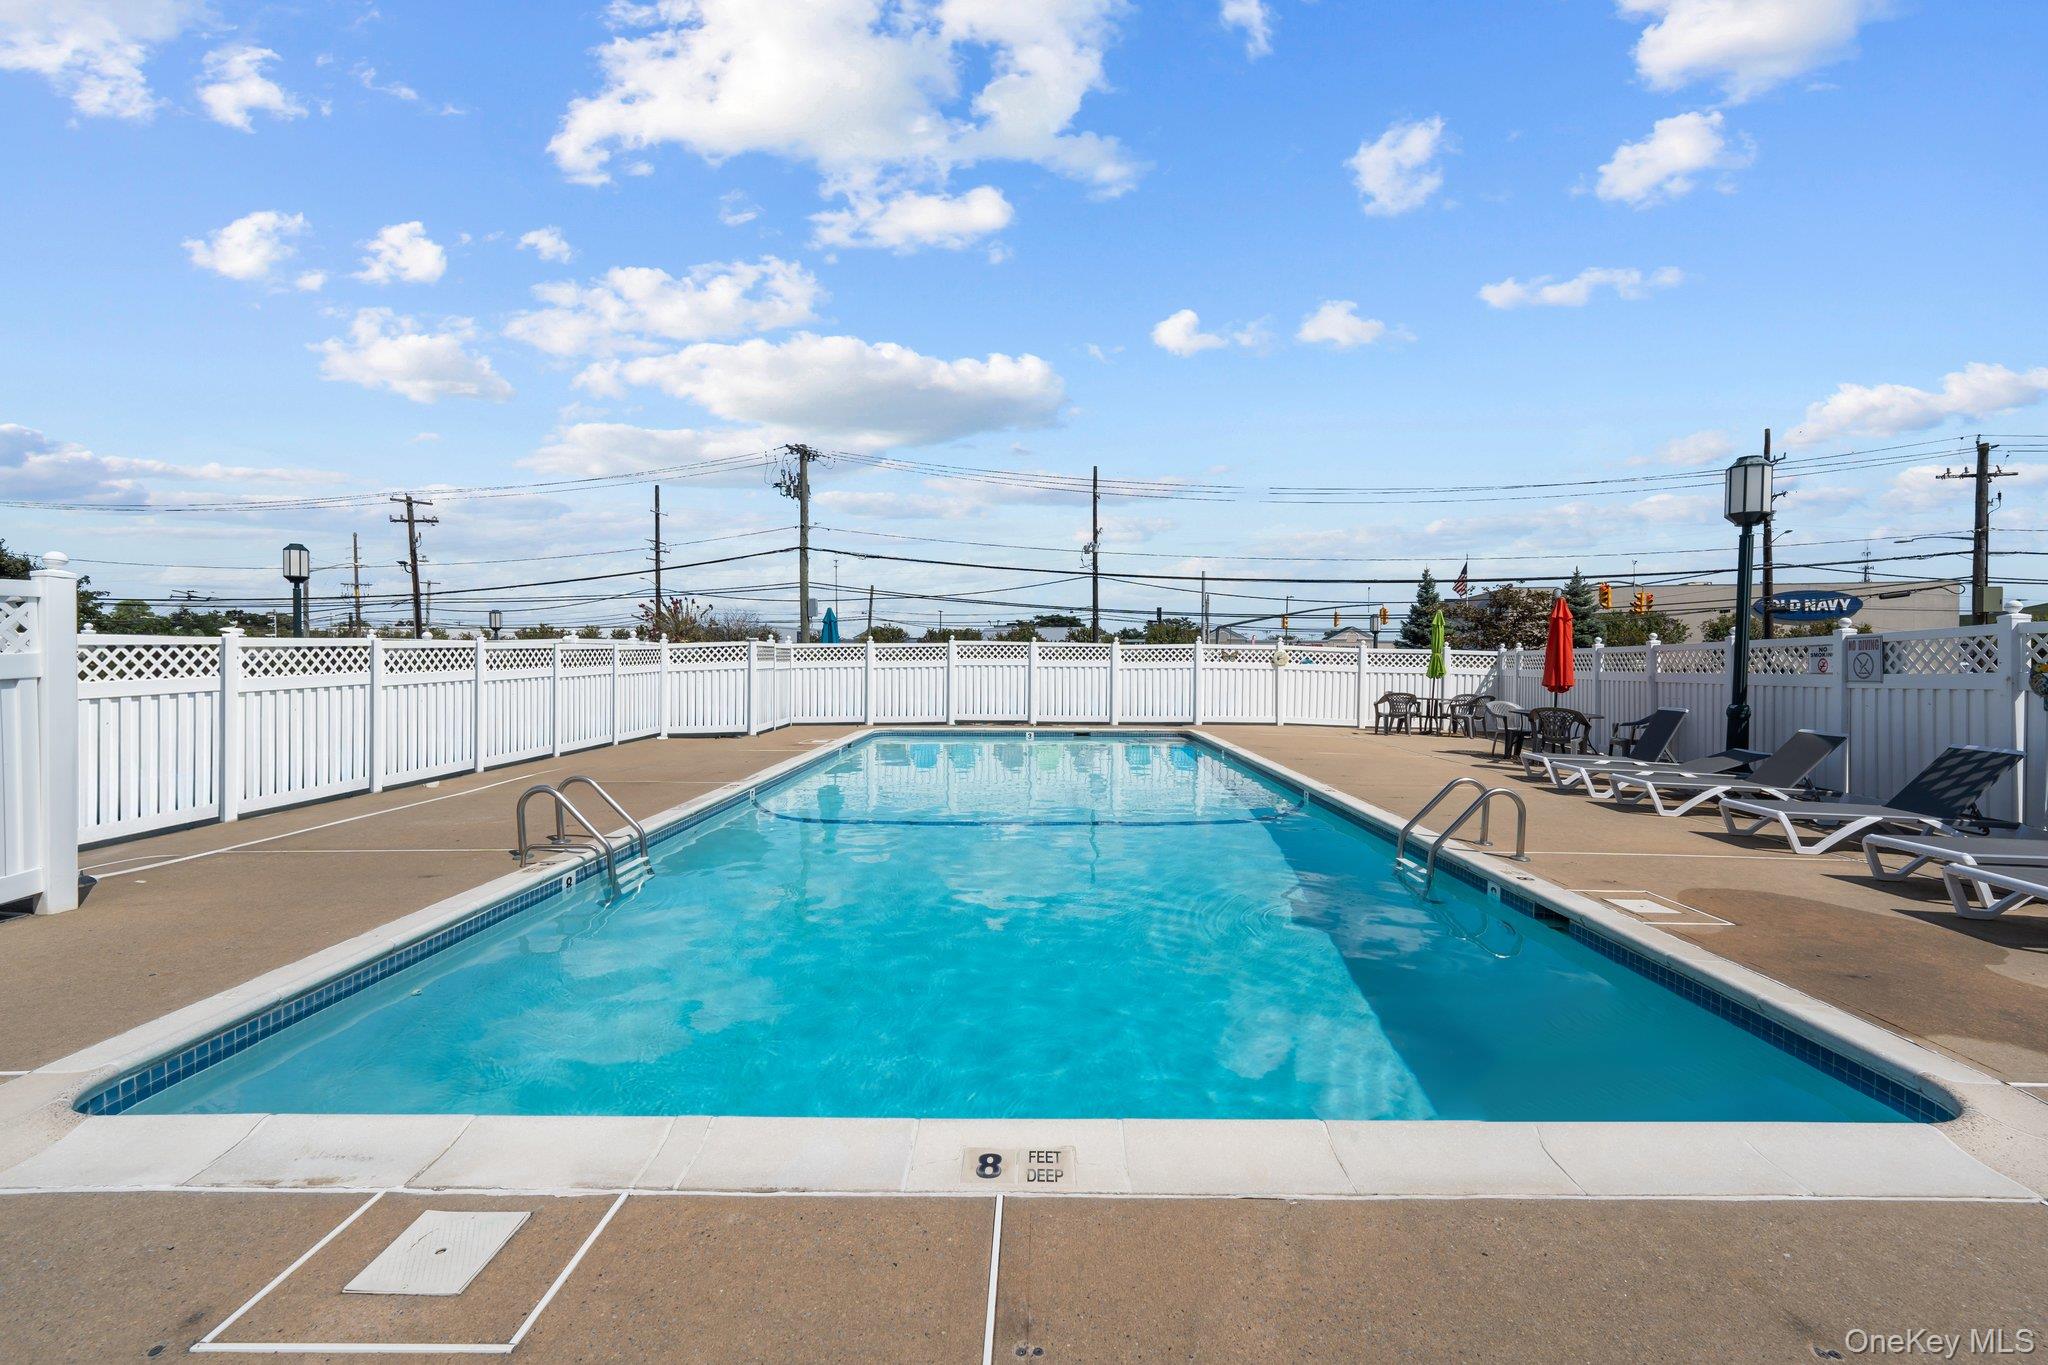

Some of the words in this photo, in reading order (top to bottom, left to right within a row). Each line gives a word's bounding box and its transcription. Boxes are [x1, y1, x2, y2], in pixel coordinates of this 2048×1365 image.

[1804, 598, 1851, 611] NAVY
[1848, 639, 1857, 651] NO
[1858, 638, 1879, 651] DIVING
[976, 1153, 1002, 1178] 8
[1028, 1150, 1061, 1164] FEET
[1027, 1168, 1064, 1182] DEEP
